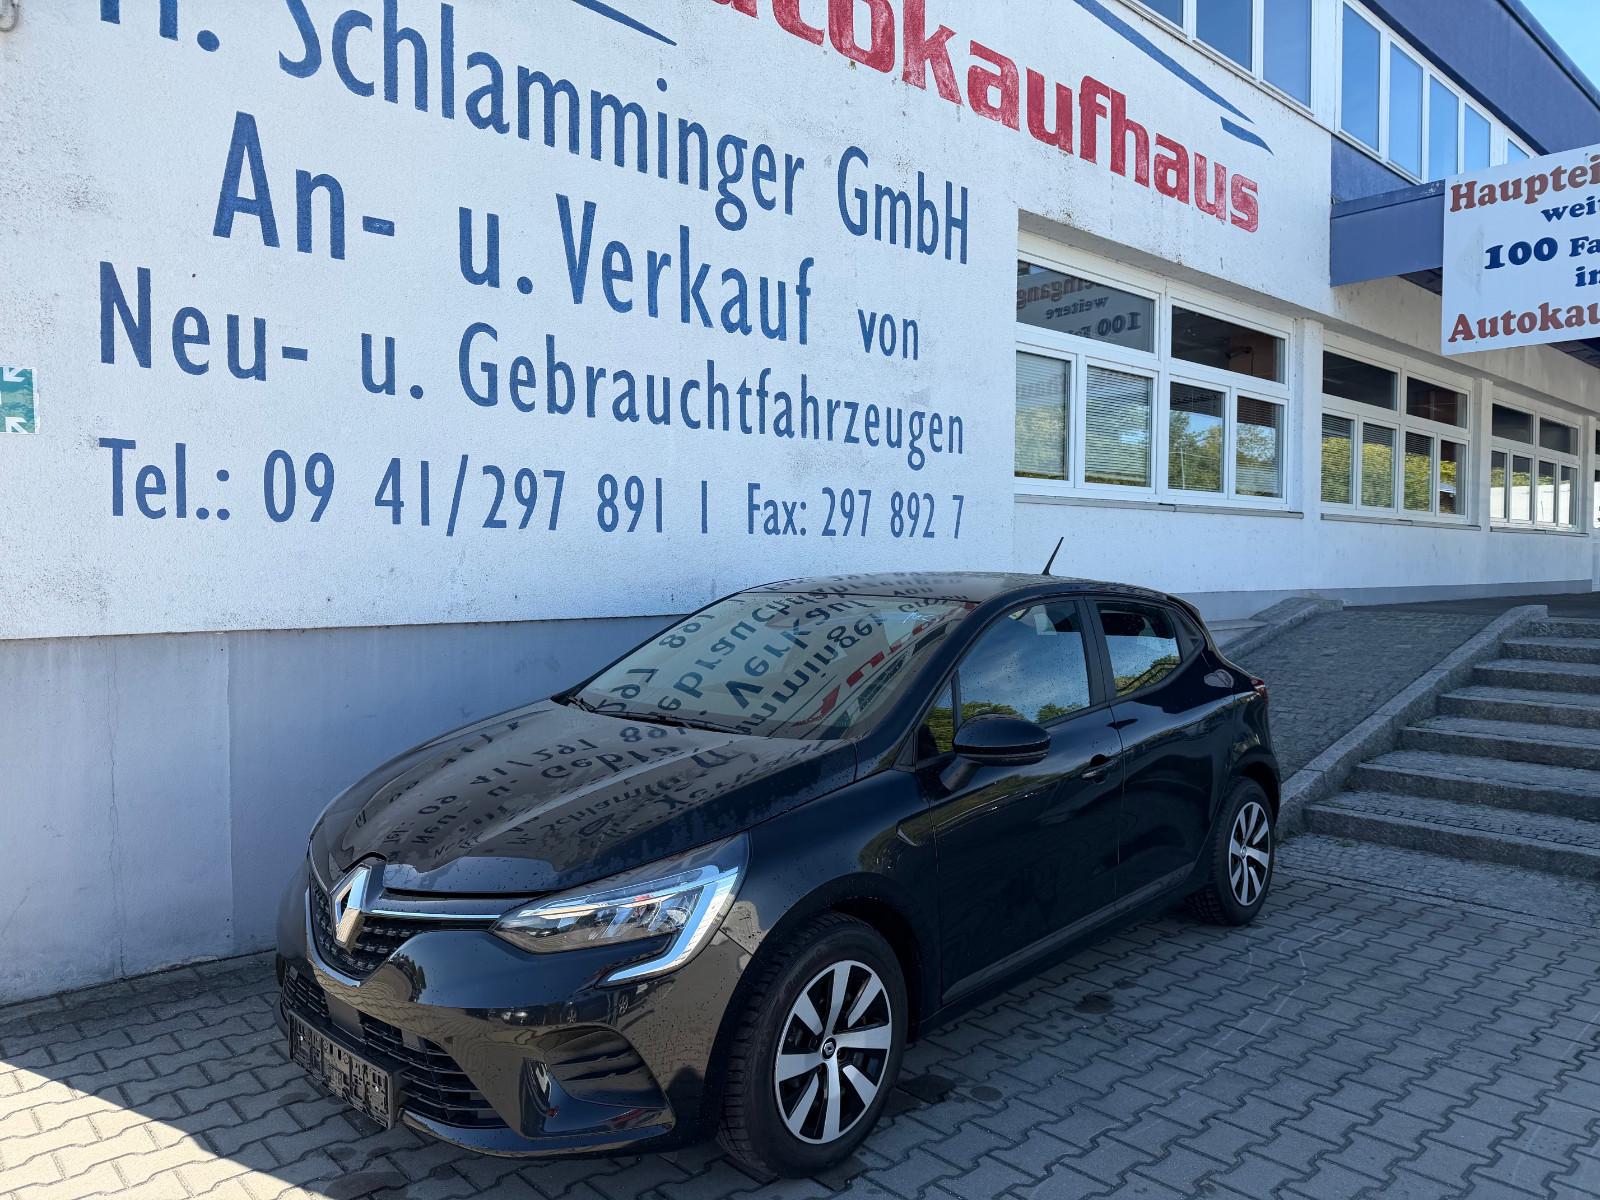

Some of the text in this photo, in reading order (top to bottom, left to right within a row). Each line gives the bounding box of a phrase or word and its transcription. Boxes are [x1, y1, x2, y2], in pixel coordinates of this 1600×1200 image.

[278, 0, 805, 232] Schlamminger
[837, 145, 969, 265] GmbH
[1540, 195, 1600, 223] wei
[212, 110, 919, 361] An- u. Verkauf von
[1484, 236, 1558, 270] 100
[99, 260, 964, 472] Neu- u. Gebrauchtfahrzeugen
[98, 437, 231, 523] Tel.:
[263, 449, 335, 523] 09
[374, 453, 566, 538] 41/297
[596, 473, 664, 534] 891
[747, 482, 806, 537] Fax:
[820, 486, 872, 538] 297
[889, 490, 936, 539] 892
[951, 494, 965, 540] 7
